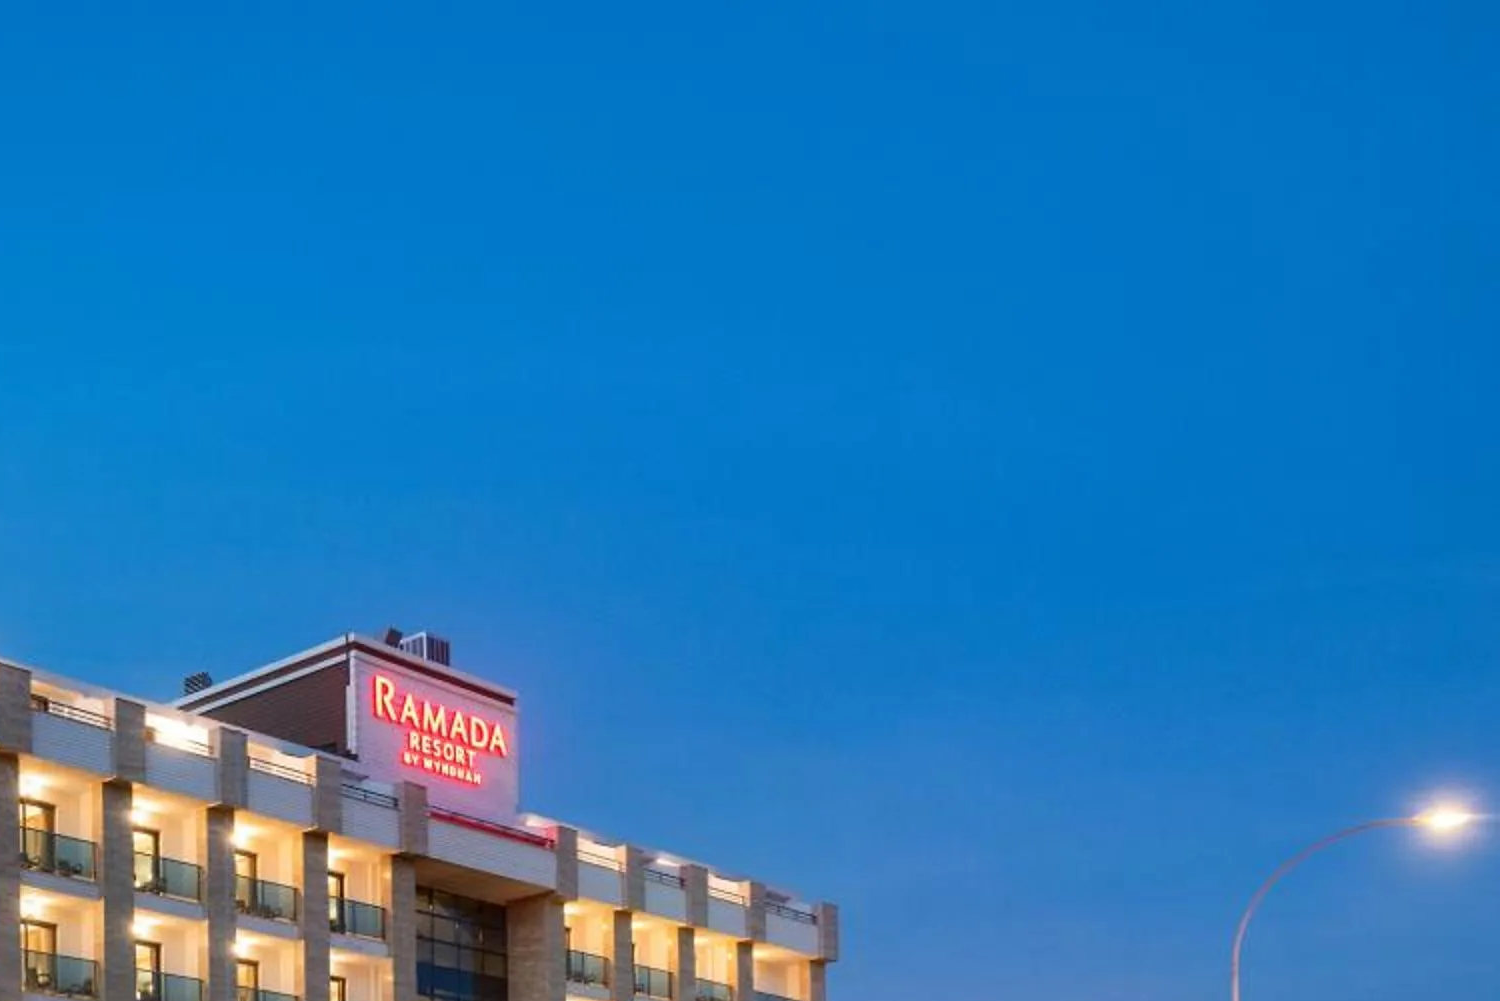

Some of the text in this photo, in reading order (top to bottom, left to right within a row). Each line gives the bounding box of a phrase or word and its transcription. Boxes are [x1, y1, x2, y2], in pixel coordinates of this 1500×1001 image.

[374, 675, 507, 756] RAMADA
[409, 732, 476, 768] RESORT
[403, 753, 482, 785] BY WYNDHAM
